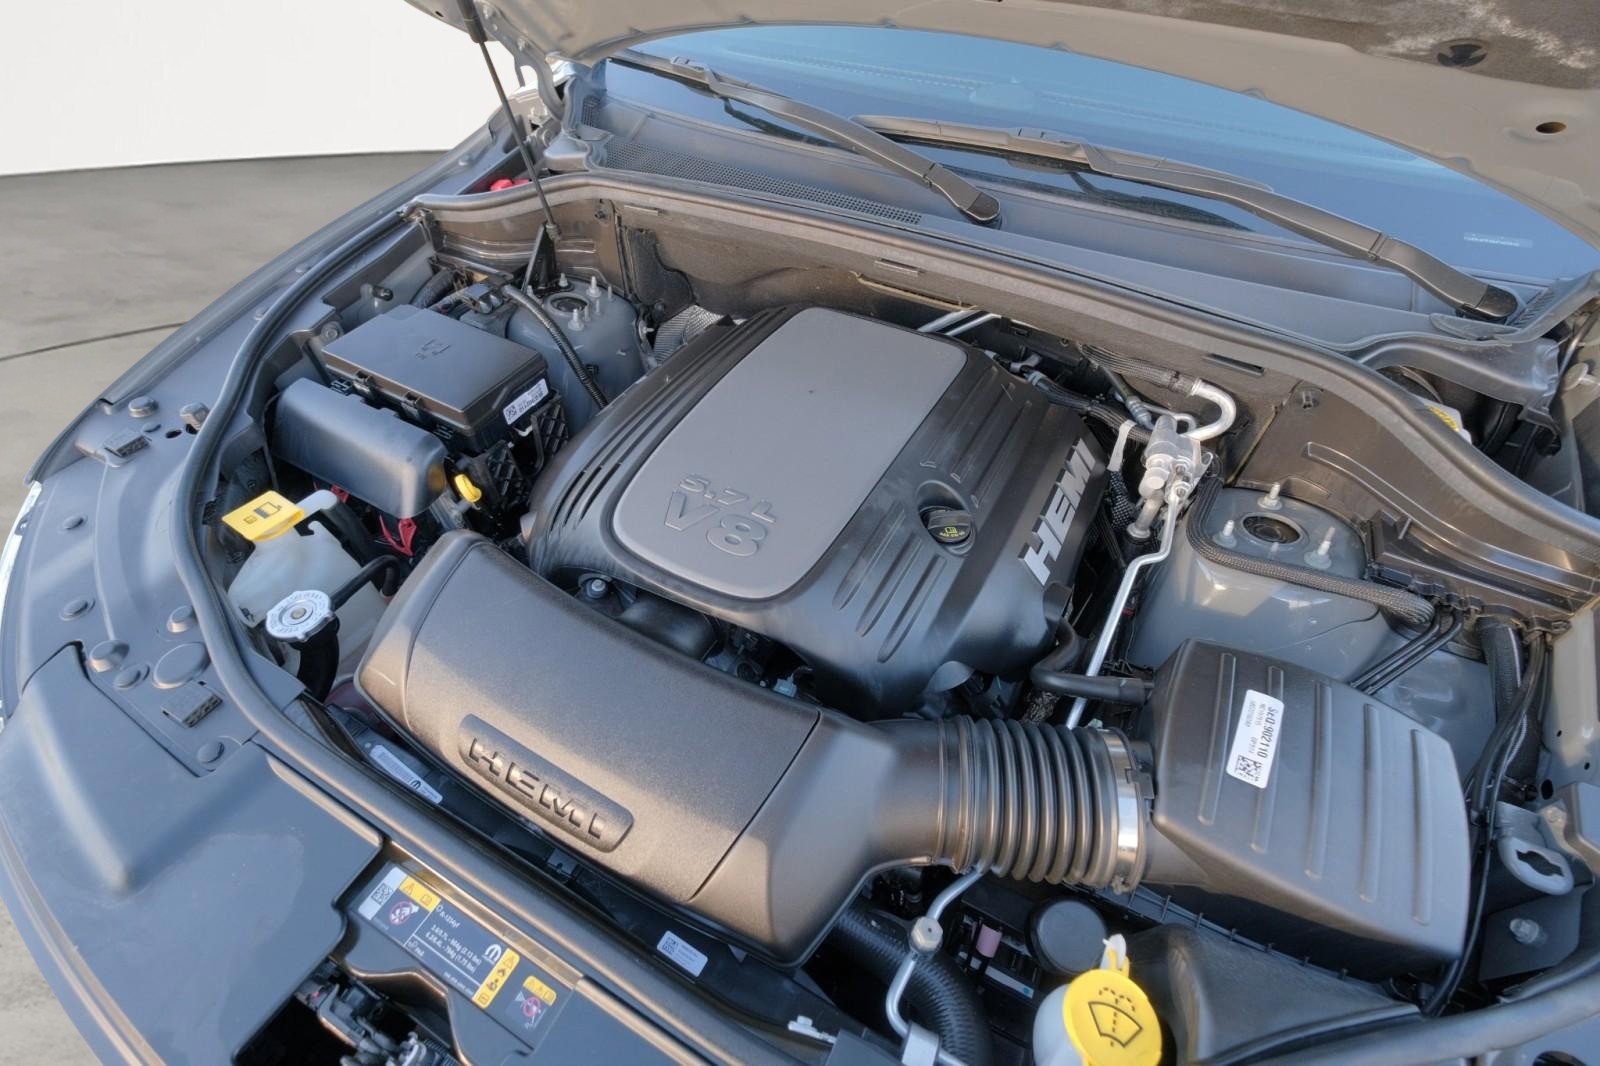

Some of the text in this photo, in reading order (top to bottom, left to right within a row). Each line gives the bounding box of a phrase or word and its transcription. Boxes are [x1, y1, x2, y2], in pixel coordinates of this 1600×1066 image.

[664, 491, 769, 557] V8
[680, 473, 777, 523] 5.7L
[1018, 438, 1096, 586] HEMI
[469, 737, 604, 840] HEMI
